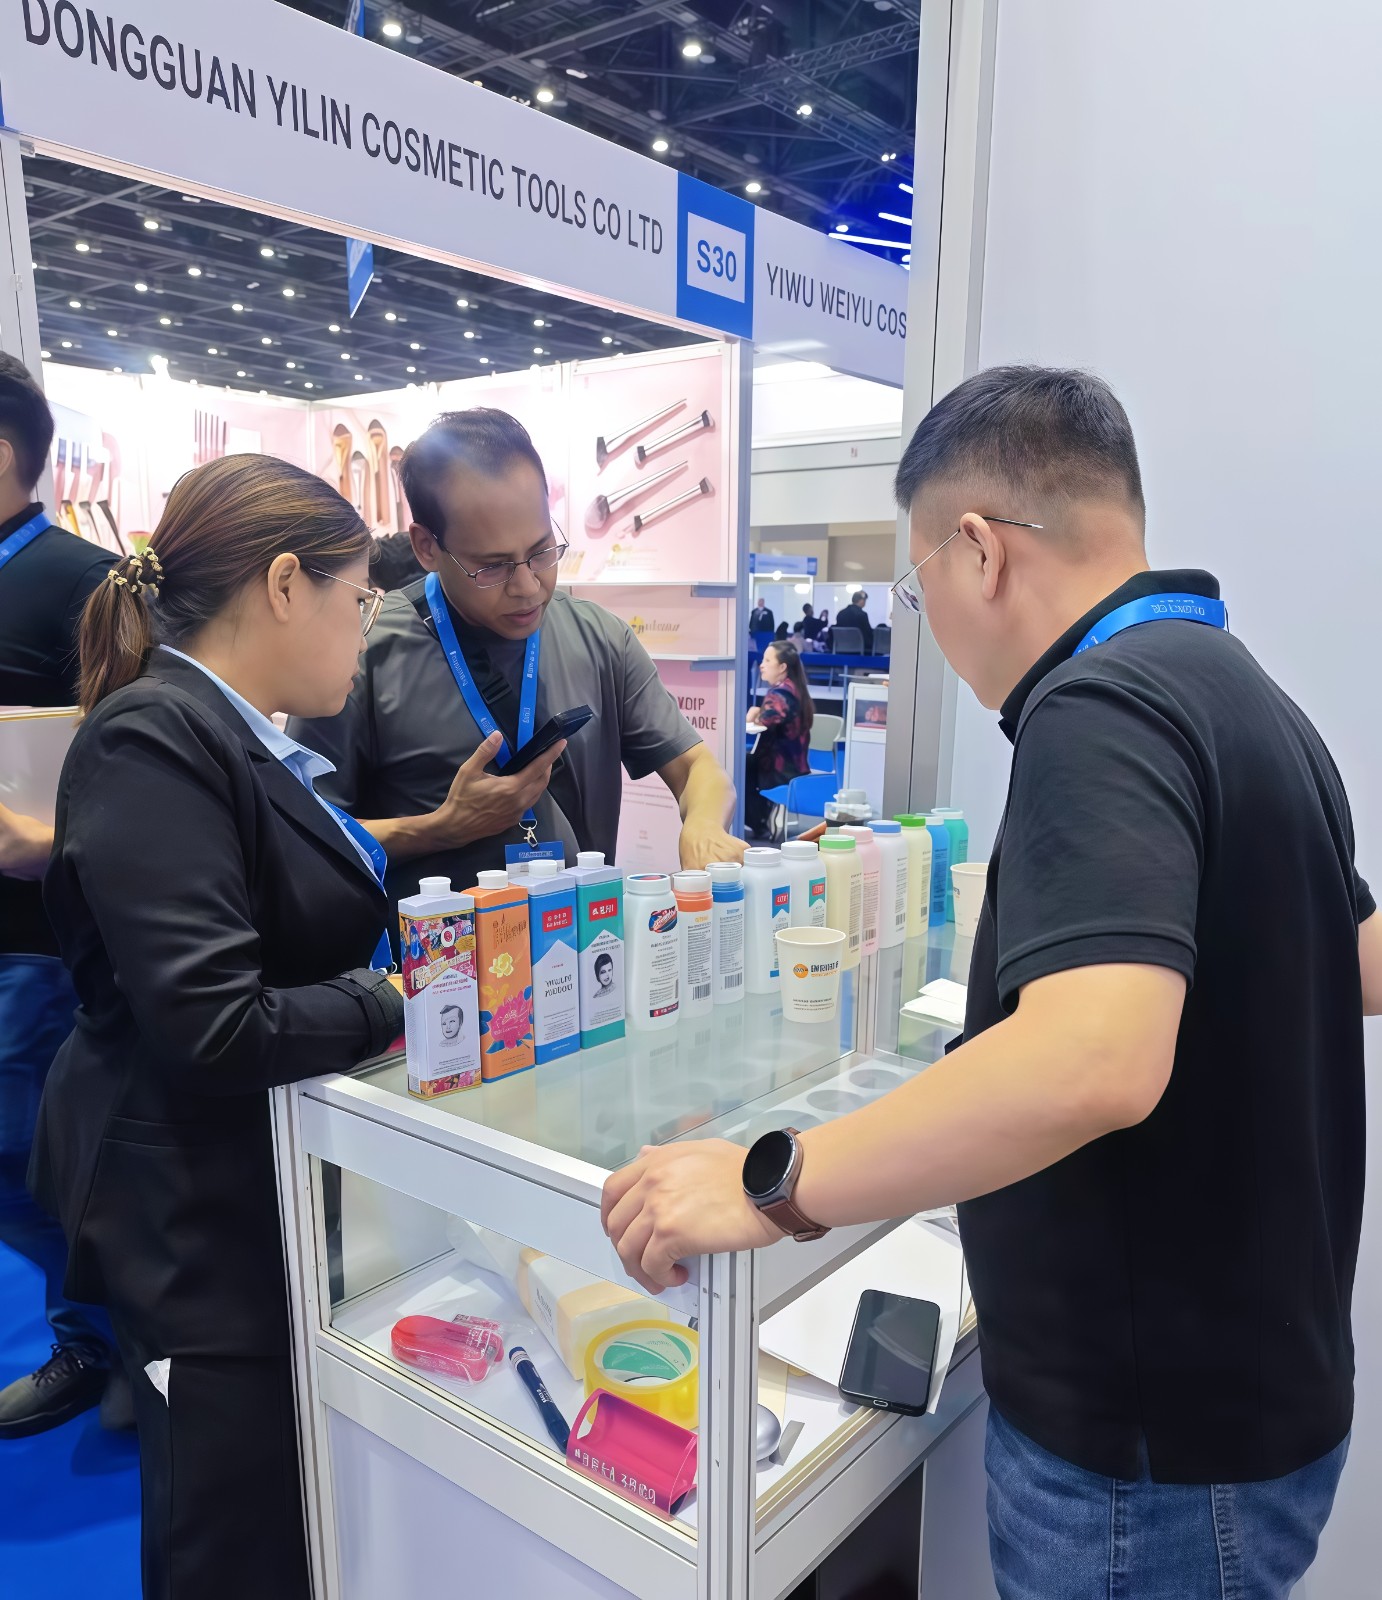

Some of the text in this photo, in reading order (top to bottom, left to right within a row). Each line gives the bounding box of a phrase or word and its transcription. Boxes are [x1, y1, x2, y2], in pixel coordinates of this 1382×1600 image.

[22, 0, 663, 254] DONGGUAN YILIN COSMETIC TOOLS CO LTD
[697, 239, 737, 282] S30
[766, 262, 907, 339] YIWU WEIYU COS
